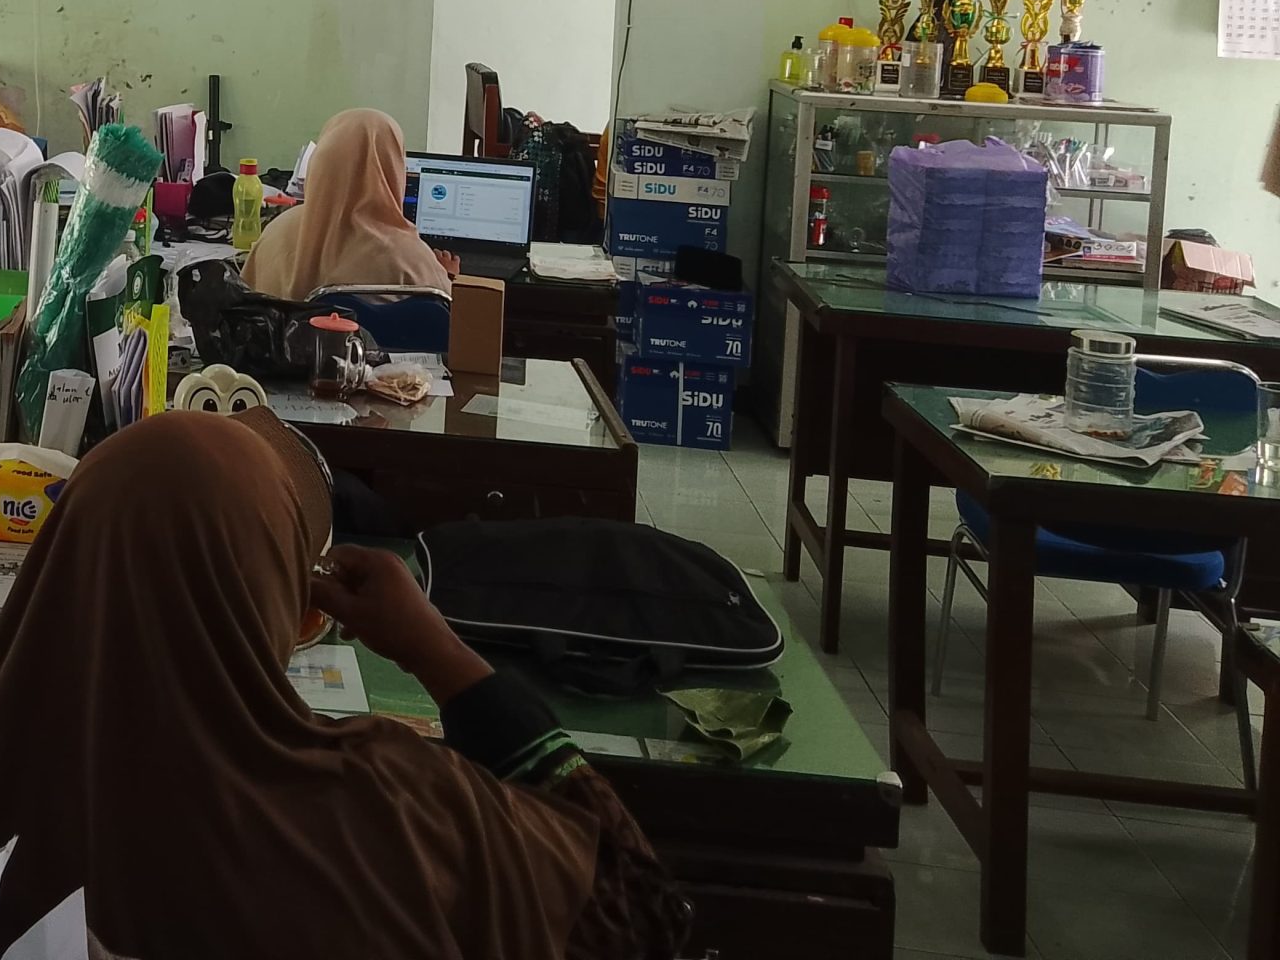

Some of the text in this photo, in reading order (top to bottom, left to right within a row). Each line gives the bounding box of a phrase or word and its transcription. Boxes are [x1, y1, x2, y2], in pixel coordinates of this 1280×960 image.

[683, 164, 695, 173] F4
[705, 227, 717, 236] F4
[618, 233, 658, 243] TRUTONE
[650, 338, 687, 348] TRUTONE
[725, 340, 741, 356] 70
[631, 419, 668, 429] TRUTONE
[705, 422, 721, 437] 70
